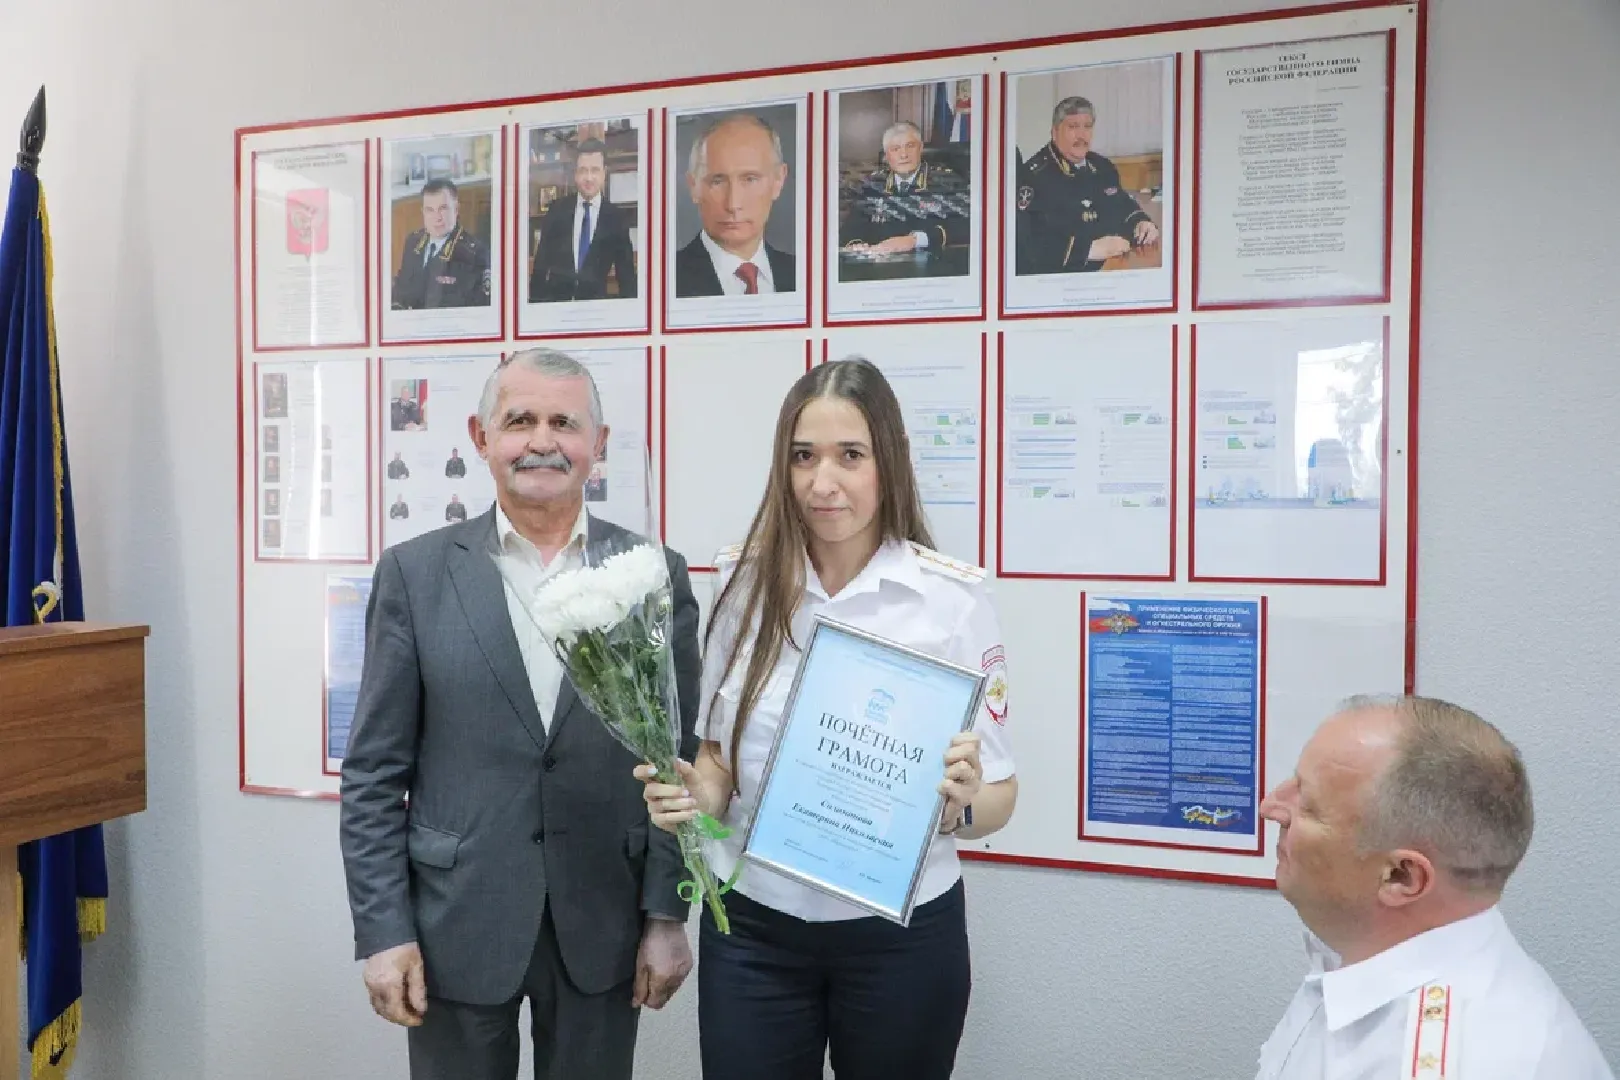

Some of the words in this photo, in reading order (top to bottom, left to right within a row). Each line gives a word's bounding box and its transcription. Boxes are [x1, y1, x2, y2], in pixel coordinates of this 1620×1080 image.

[817, 736, 909, 784] ГРАМОТА
[820, 712, 924, 763] ПОЧЁТНАЯ
[831, 761, 892, 790] НАГРАЖДАЕТСЯ
